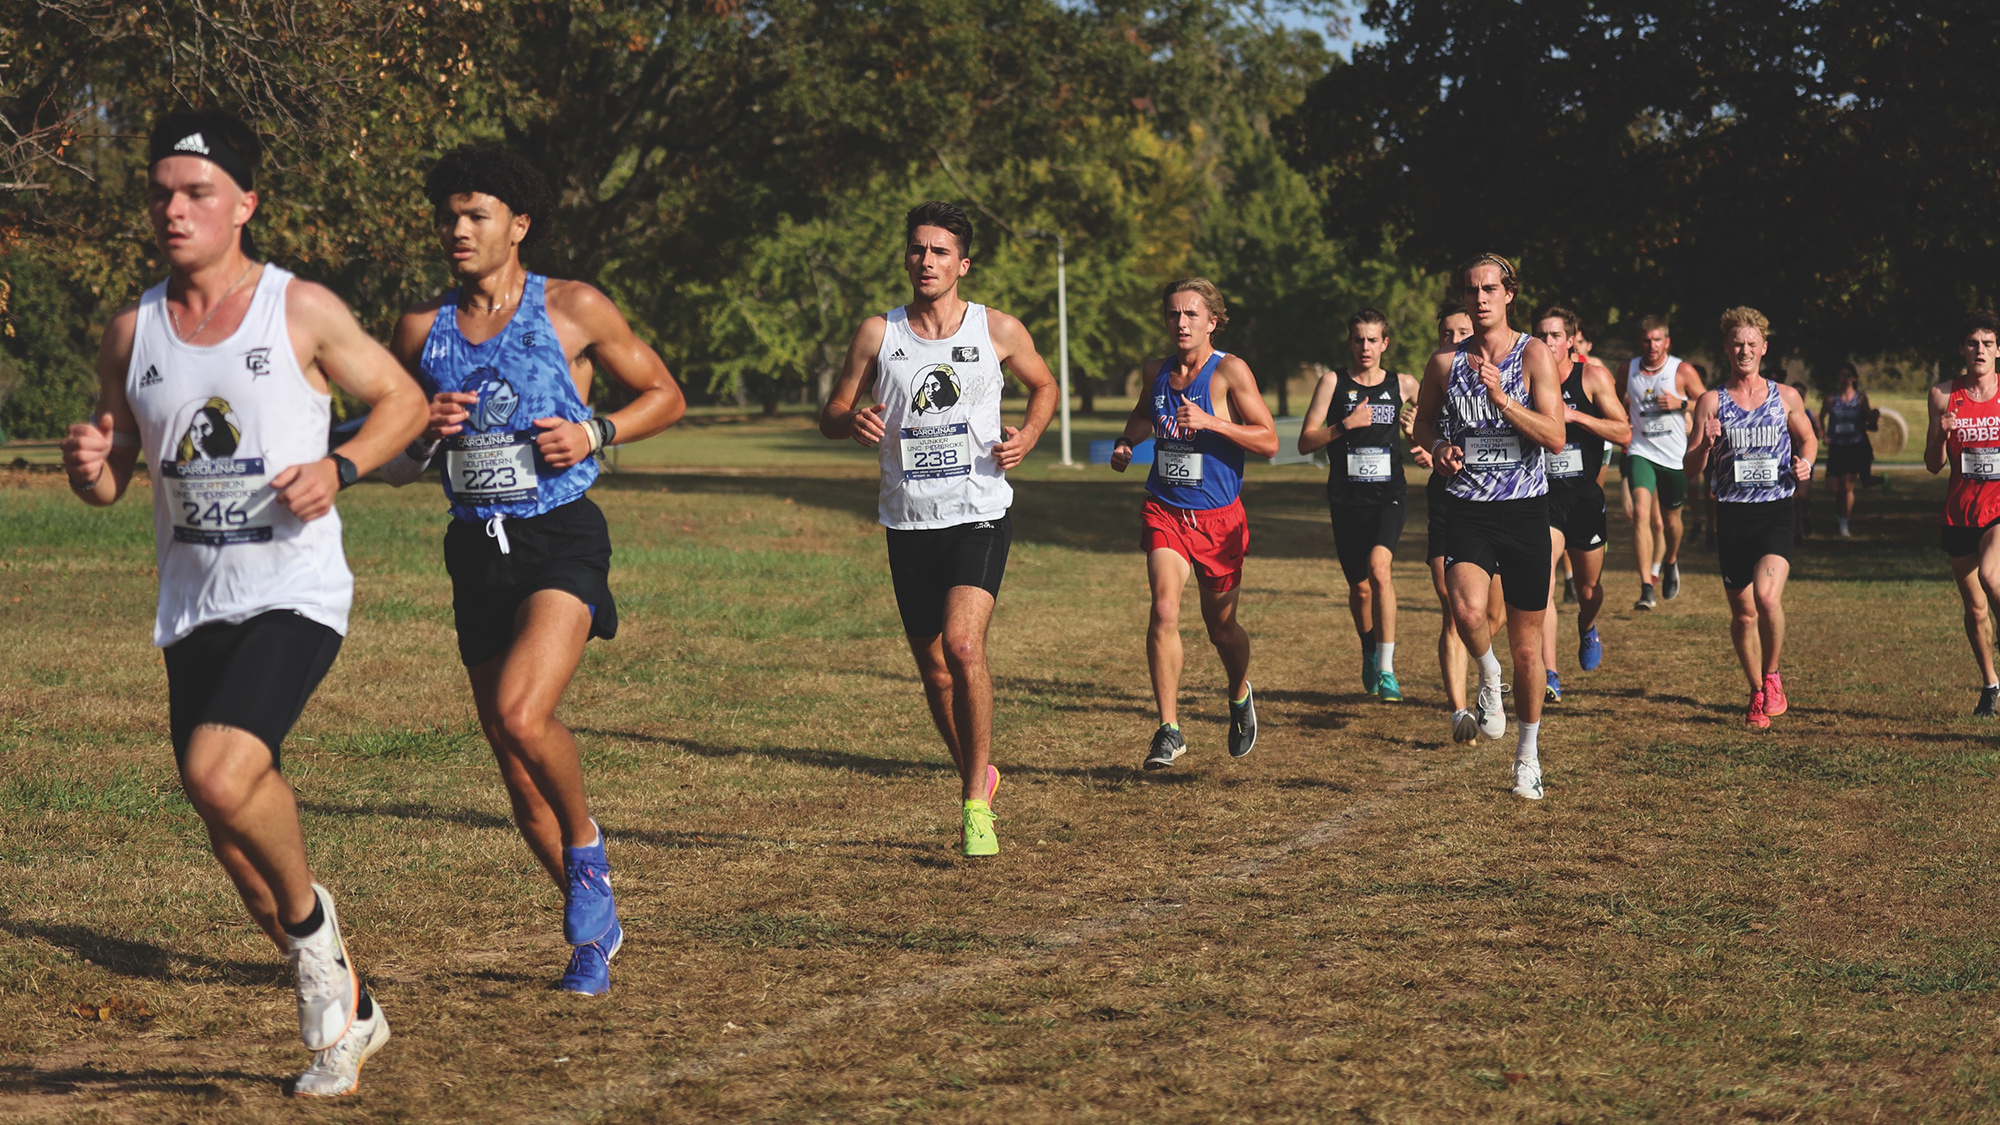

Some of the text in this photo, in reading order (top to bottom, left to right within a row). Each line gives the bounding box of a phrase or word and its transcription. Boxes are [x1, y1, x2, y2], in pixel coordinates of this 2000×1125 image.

[1455, 395, 1484, 421] YOUNG
[1646, 423, 1665, 432] 143
[1955, 416, 2000, 429] BELMON
[912, 426, 957, 437] CAROLINAS
[1726, 425, 1780, 448] YOUNG HARRIS
[1957, 427, 2000, 442] ABBE
[457, 434, 515, 448] CAROLINAS
[925, 442, 964, 451] PEMBROKE
[467, 450, 504, 460] REEDER
[914, 449, 958, 468] 238
[1477, 448, 1508, 462] 271
[177, 462, 247, 476] CAROLINAS
[462, 458, 512, 468] SOUTHERN
[1165, 462, 1190, 477] 126
[1359, 464, 1378, 475] 62
[1550, 460, 1569, 472] 59
[1974, 463, 1994, 473] 20
[462, 467, 517, 490] 223
[1743, 469, 1772, 480] 268
[178, 481, 244, 491] ROBERTSON
[182, 501, 249, 527] 246
